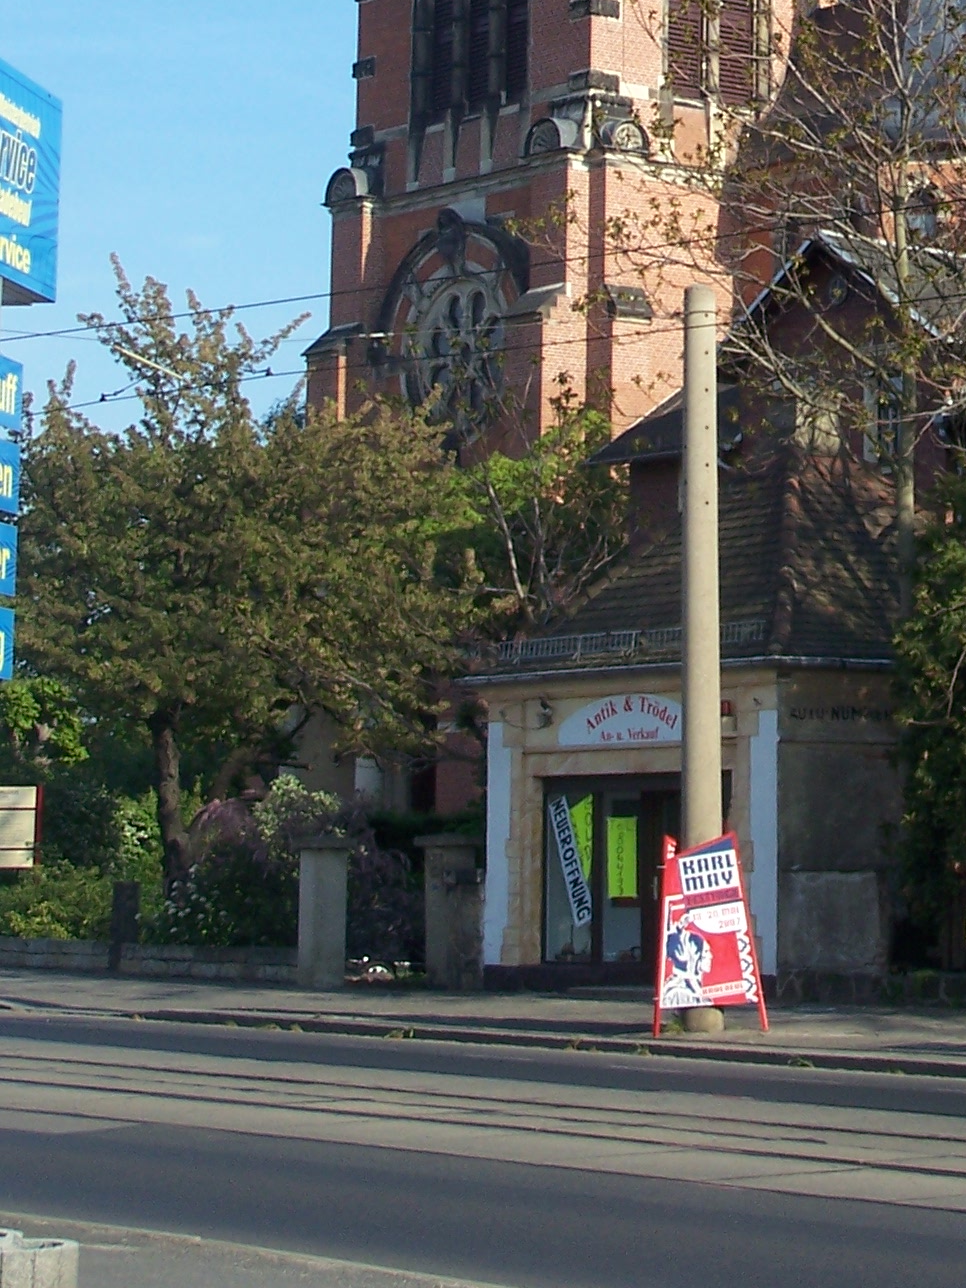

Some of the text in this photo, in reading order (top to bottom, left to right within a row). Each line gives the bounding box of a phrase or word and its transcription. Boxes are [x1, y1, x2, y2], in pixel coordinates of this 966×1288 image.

[0, 128, 38, 195] rvice
[0, 234, 31, 275] rvice
[586, 696, 678, 733] Antik & Trödel
[627, 726, 659, 741] Verkauf
[682, 853, 734, 875] KARL
[684, 869, 733, 892] MAY
[718, 916, 741, 929] 2007
